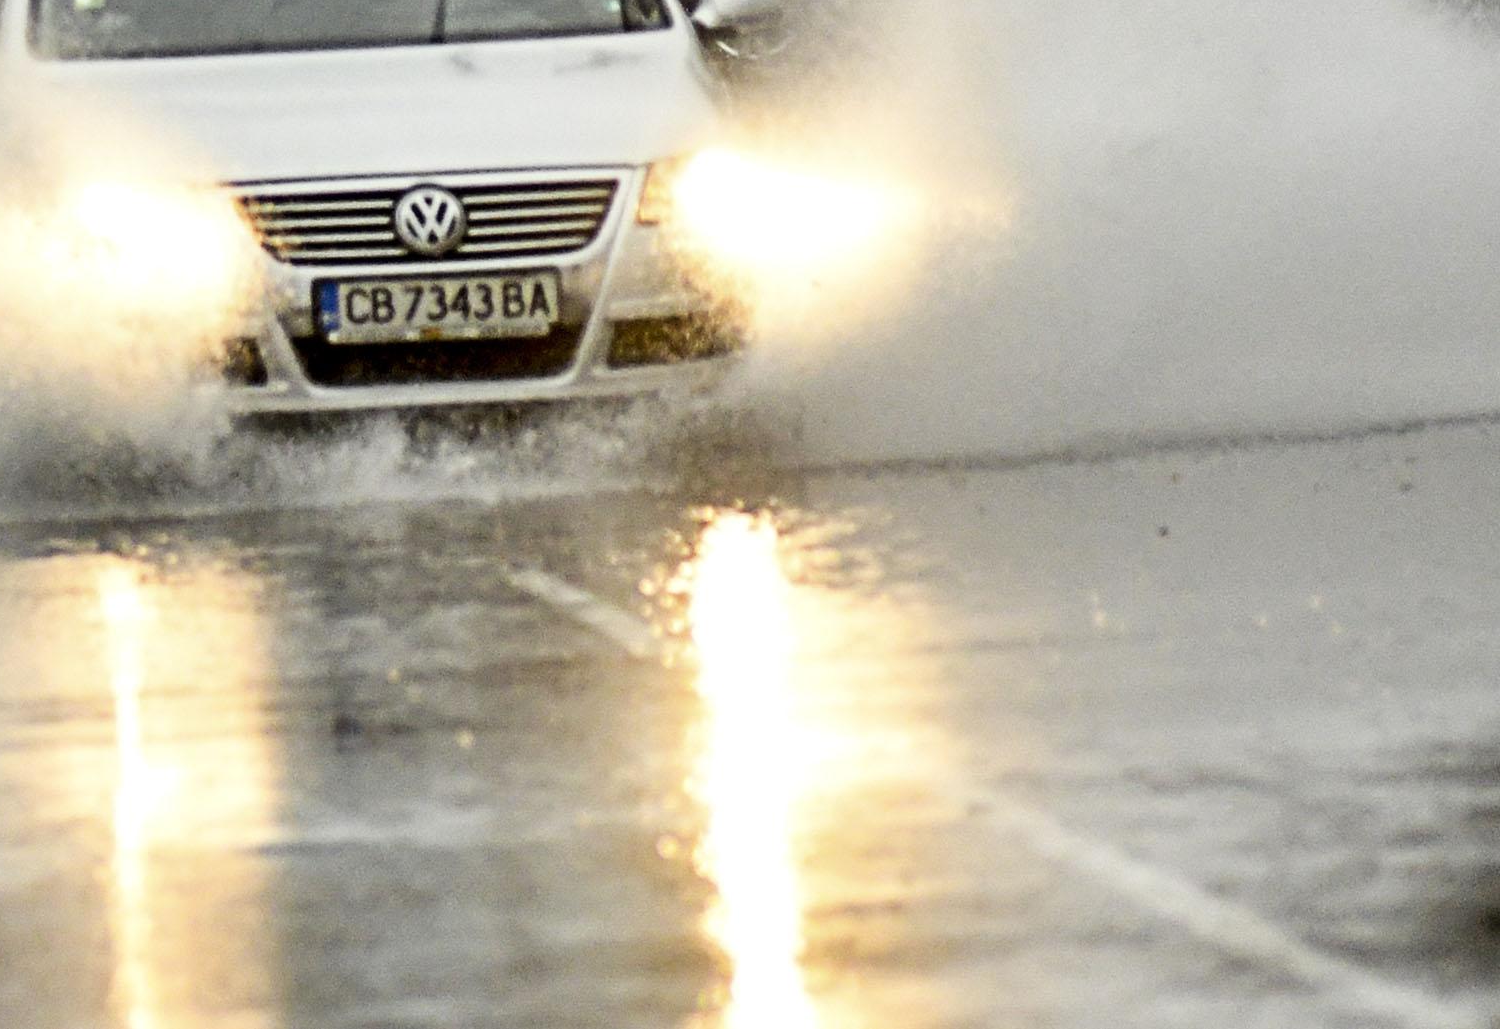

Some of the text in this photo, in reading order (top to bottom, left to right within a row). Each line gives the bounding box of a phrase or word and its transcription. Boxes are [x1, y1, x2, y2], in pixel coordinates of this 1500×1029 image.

[346, 279, 550, 324] CB 7343 BA
